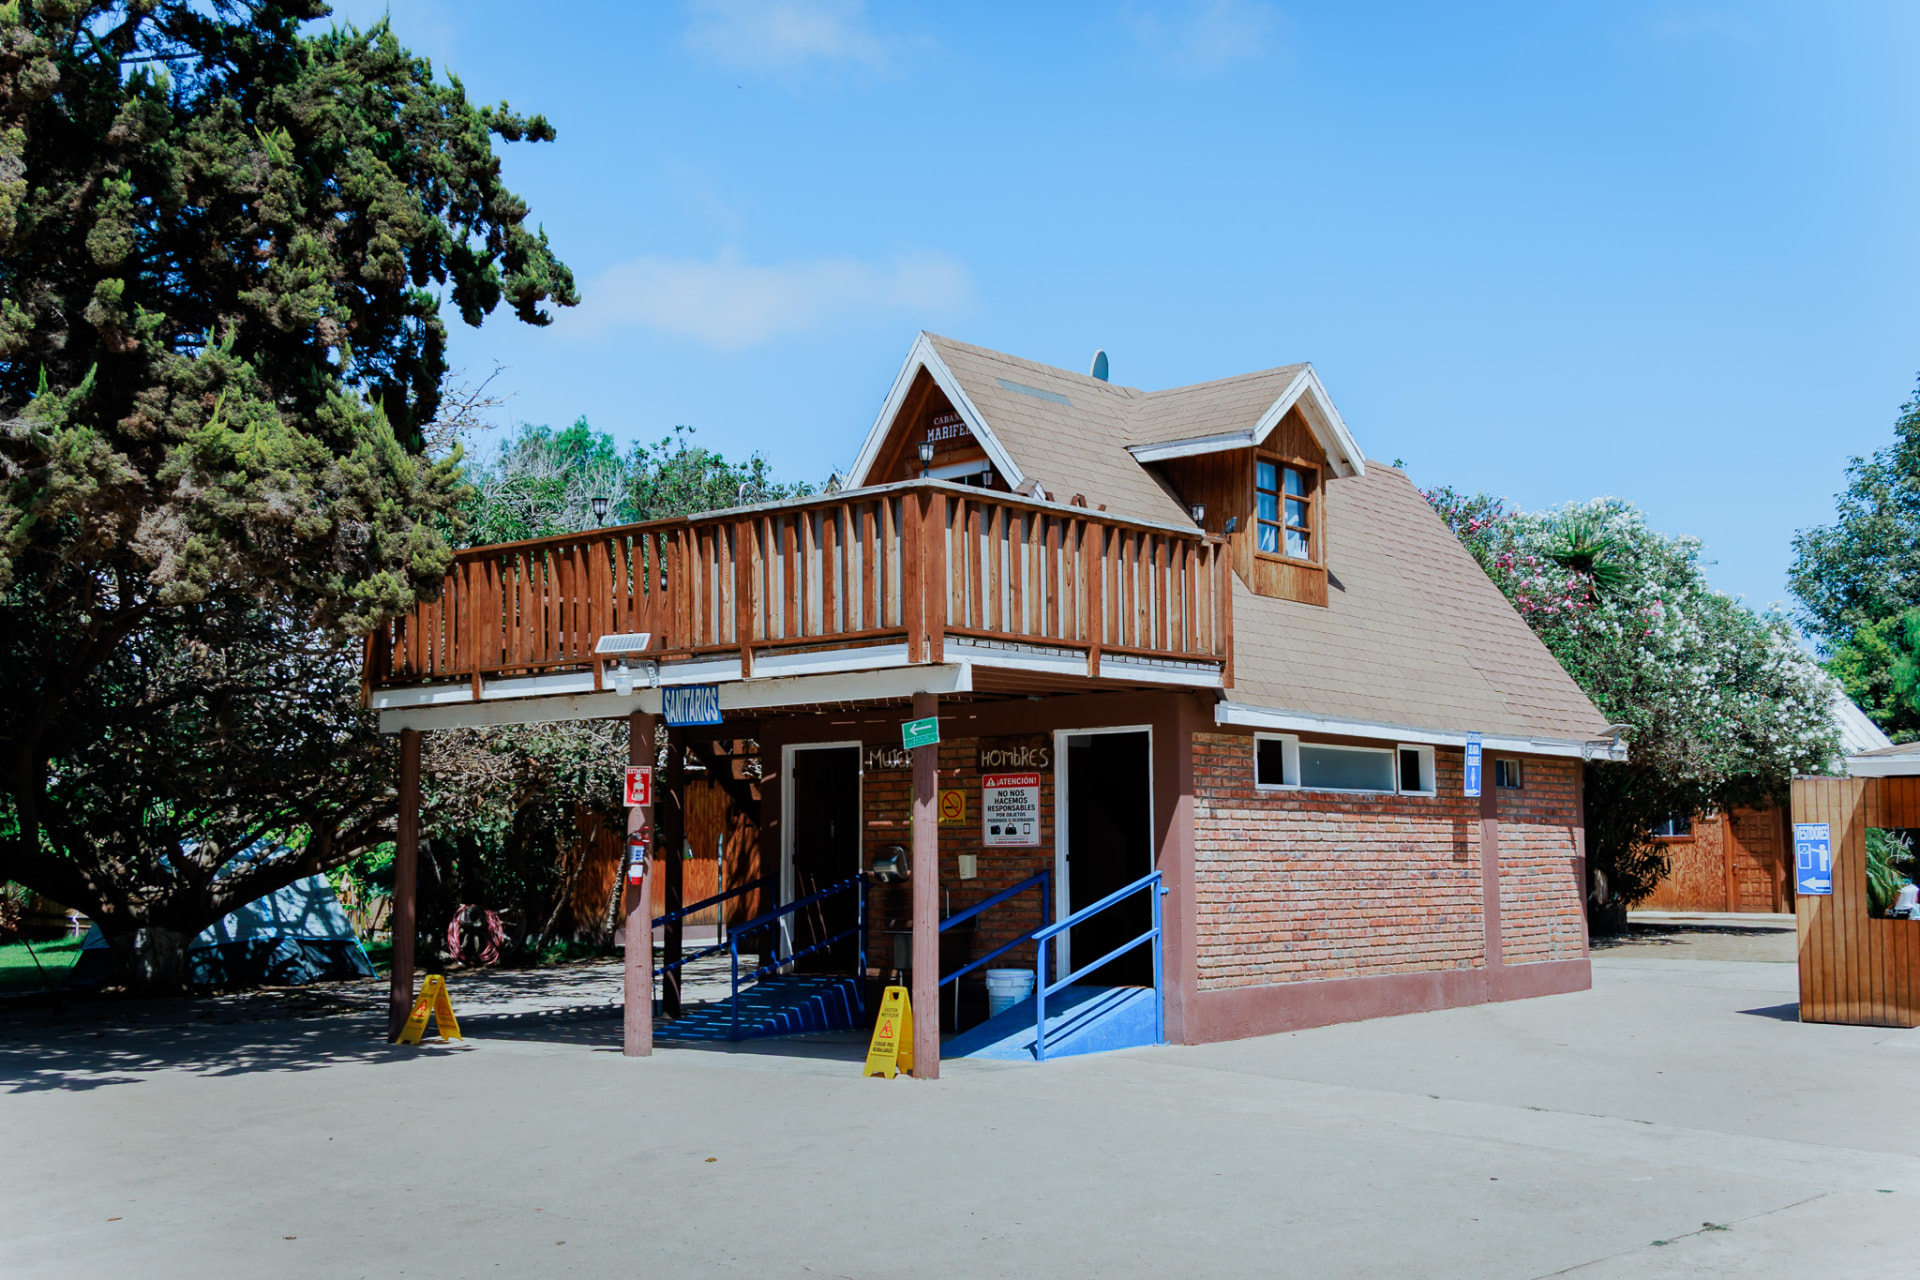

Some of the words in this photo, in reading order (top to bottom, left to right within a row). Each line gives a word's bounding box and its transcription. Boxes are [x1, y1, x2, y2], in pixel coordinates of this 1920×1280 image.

[934, 413, 962, 425] CABAN
[664, 687, 719, 723] SANITARIOS
[996, 776, 1037, 787] ¡ATENCIÓN!
[1010, 789, 1025, 797] NOS
[994, 797, 1028, 805] HACEMOS
[987, 804, 1036, 812] RESPONSABLES
